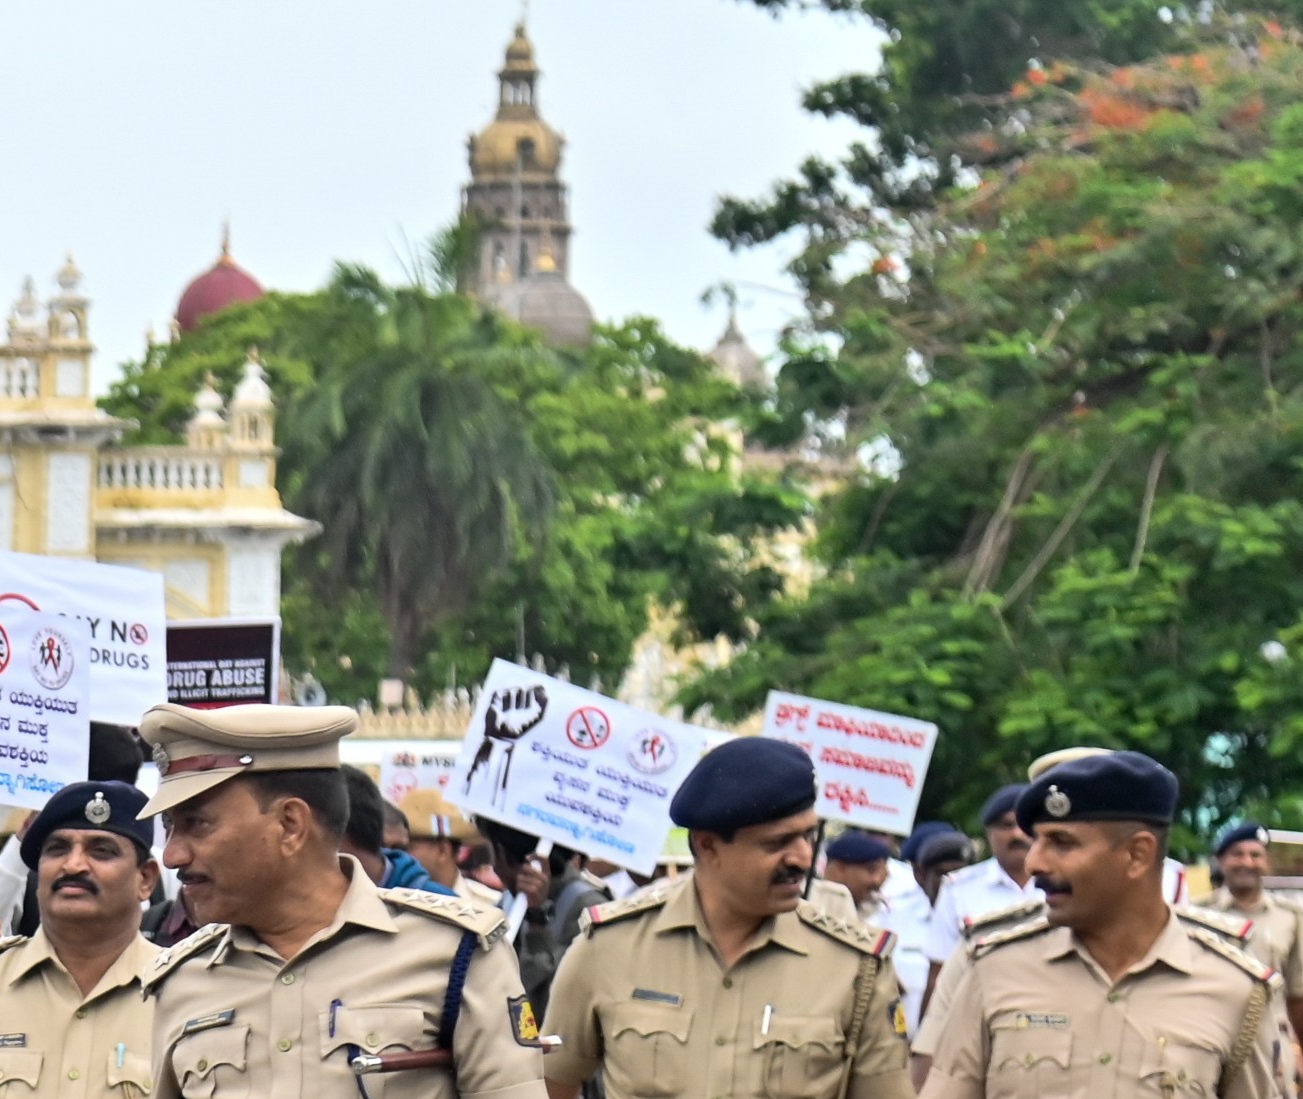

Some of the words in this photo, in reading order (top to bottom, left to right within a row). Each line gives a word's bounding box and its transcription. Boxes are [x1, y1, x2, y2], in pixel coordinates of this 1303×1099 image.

[89, 647, 150, 670] DRUGS
[167, 660, 217, 670] NTERNATIONAL
[167, 670, 207, 688] DRUG
[211, 667, 265, 686] ABUSE
[9, 691, 78, 716] ಯುಕ್ತಿಯುತ
[18, 720, 49, 744] ಮುಕ್ತ
